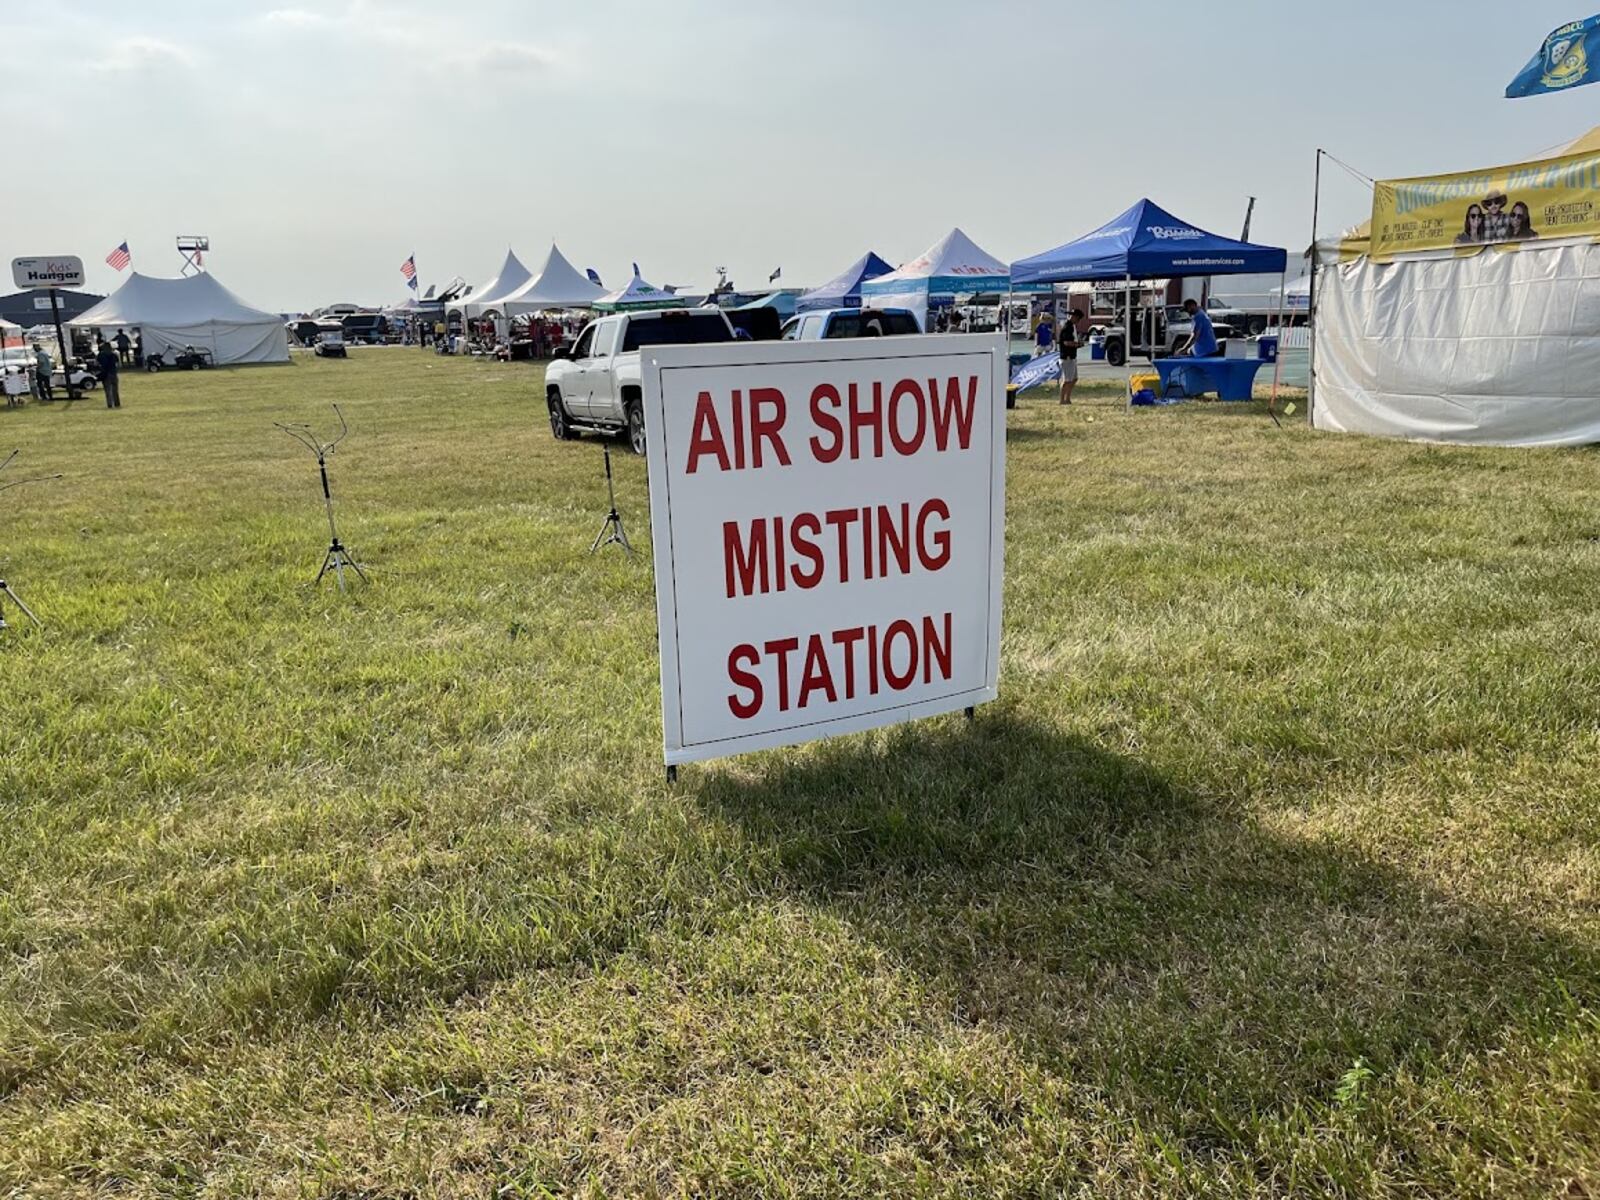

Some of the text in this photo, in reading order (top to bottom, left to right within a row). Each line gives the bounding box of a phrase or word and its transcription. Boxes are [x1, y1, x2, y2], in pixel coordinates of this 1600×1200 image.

[28, 271, 80, 281] Hangar
[685, 376, 979, 475] AIR SHOW
[722, 498, 952, 599] MISTING
[727, 612, 952, 719] STATION
